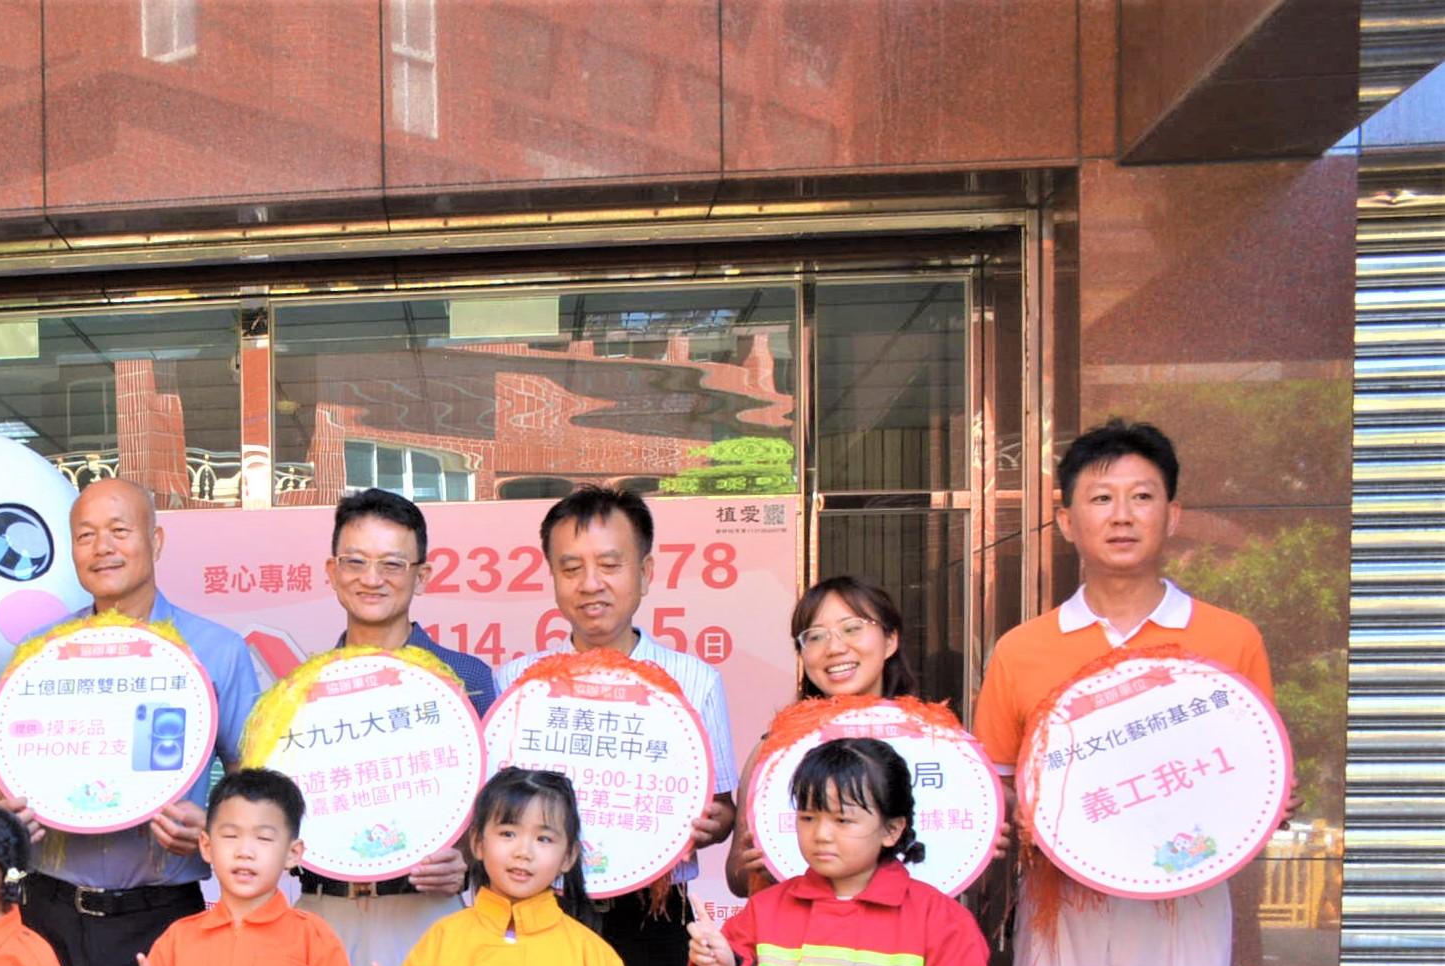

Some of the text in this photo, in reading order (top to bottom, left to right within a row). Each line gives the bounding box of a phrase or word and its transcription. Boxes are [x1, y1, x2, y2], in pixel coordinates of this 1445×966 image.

[716, 505, 760, 523] 植愛
[204, 564, 312, 594] 愛心專線
[18, 675, 187, 697] 上億國際雙B進口車
[280, 700, 440, 752] 大九九大賣場
[546, 706, 646, 736] 嘉義市立
[17, 740, 91, 757] IPHONE
[519, 729, 668, 763] 玉山國民中學
[911, 762, 944, 789] 局
[1081, 747, 1235, 823] 義工我+1
